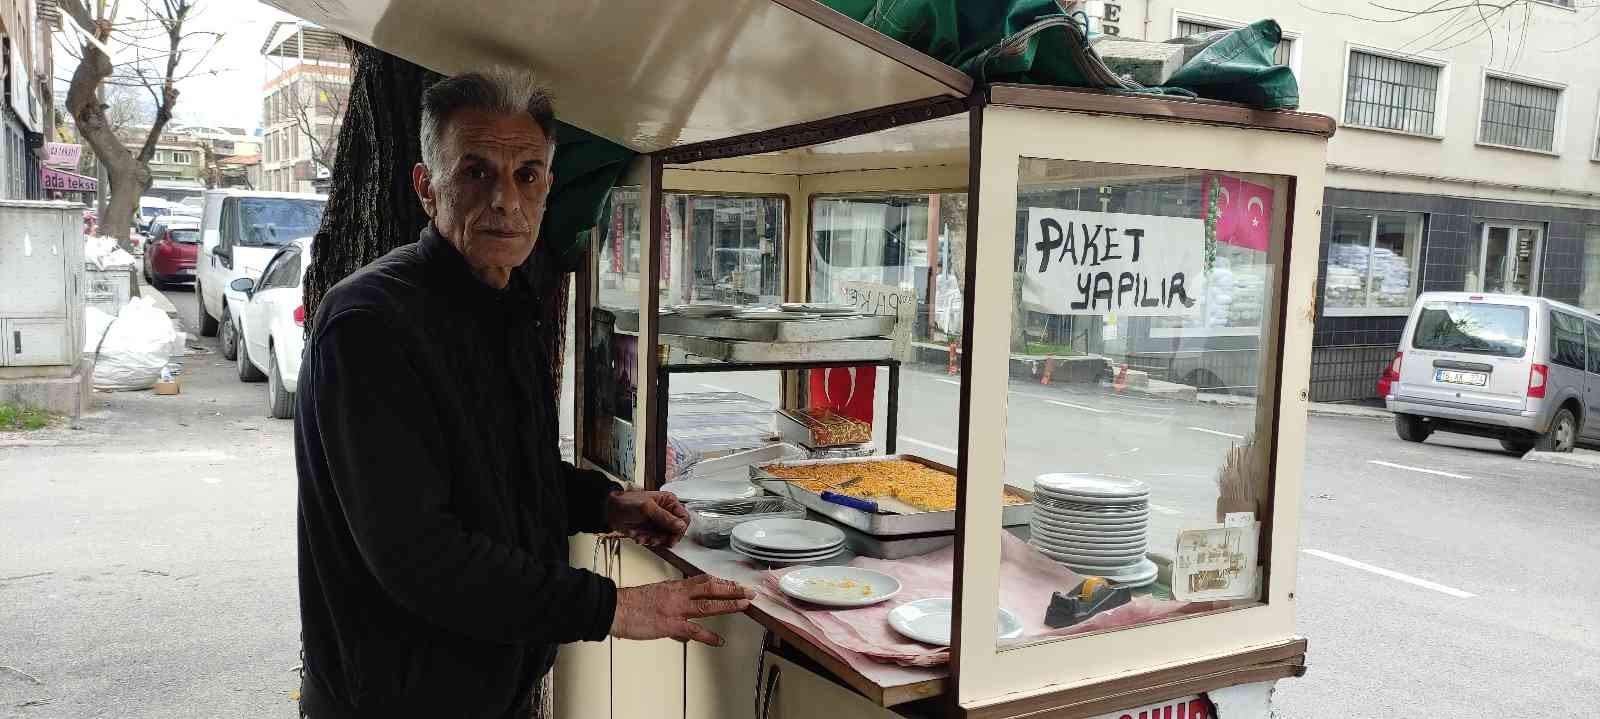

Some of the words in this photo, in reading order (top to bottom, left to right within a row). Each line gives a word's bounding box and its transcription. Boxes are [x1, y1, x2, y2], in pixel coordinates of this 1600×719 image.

[45, 174, 64, 188] ada
[1035, 218, 1145, 272] PAKET
[1071, 272, 1195, 311] YAPILIR
